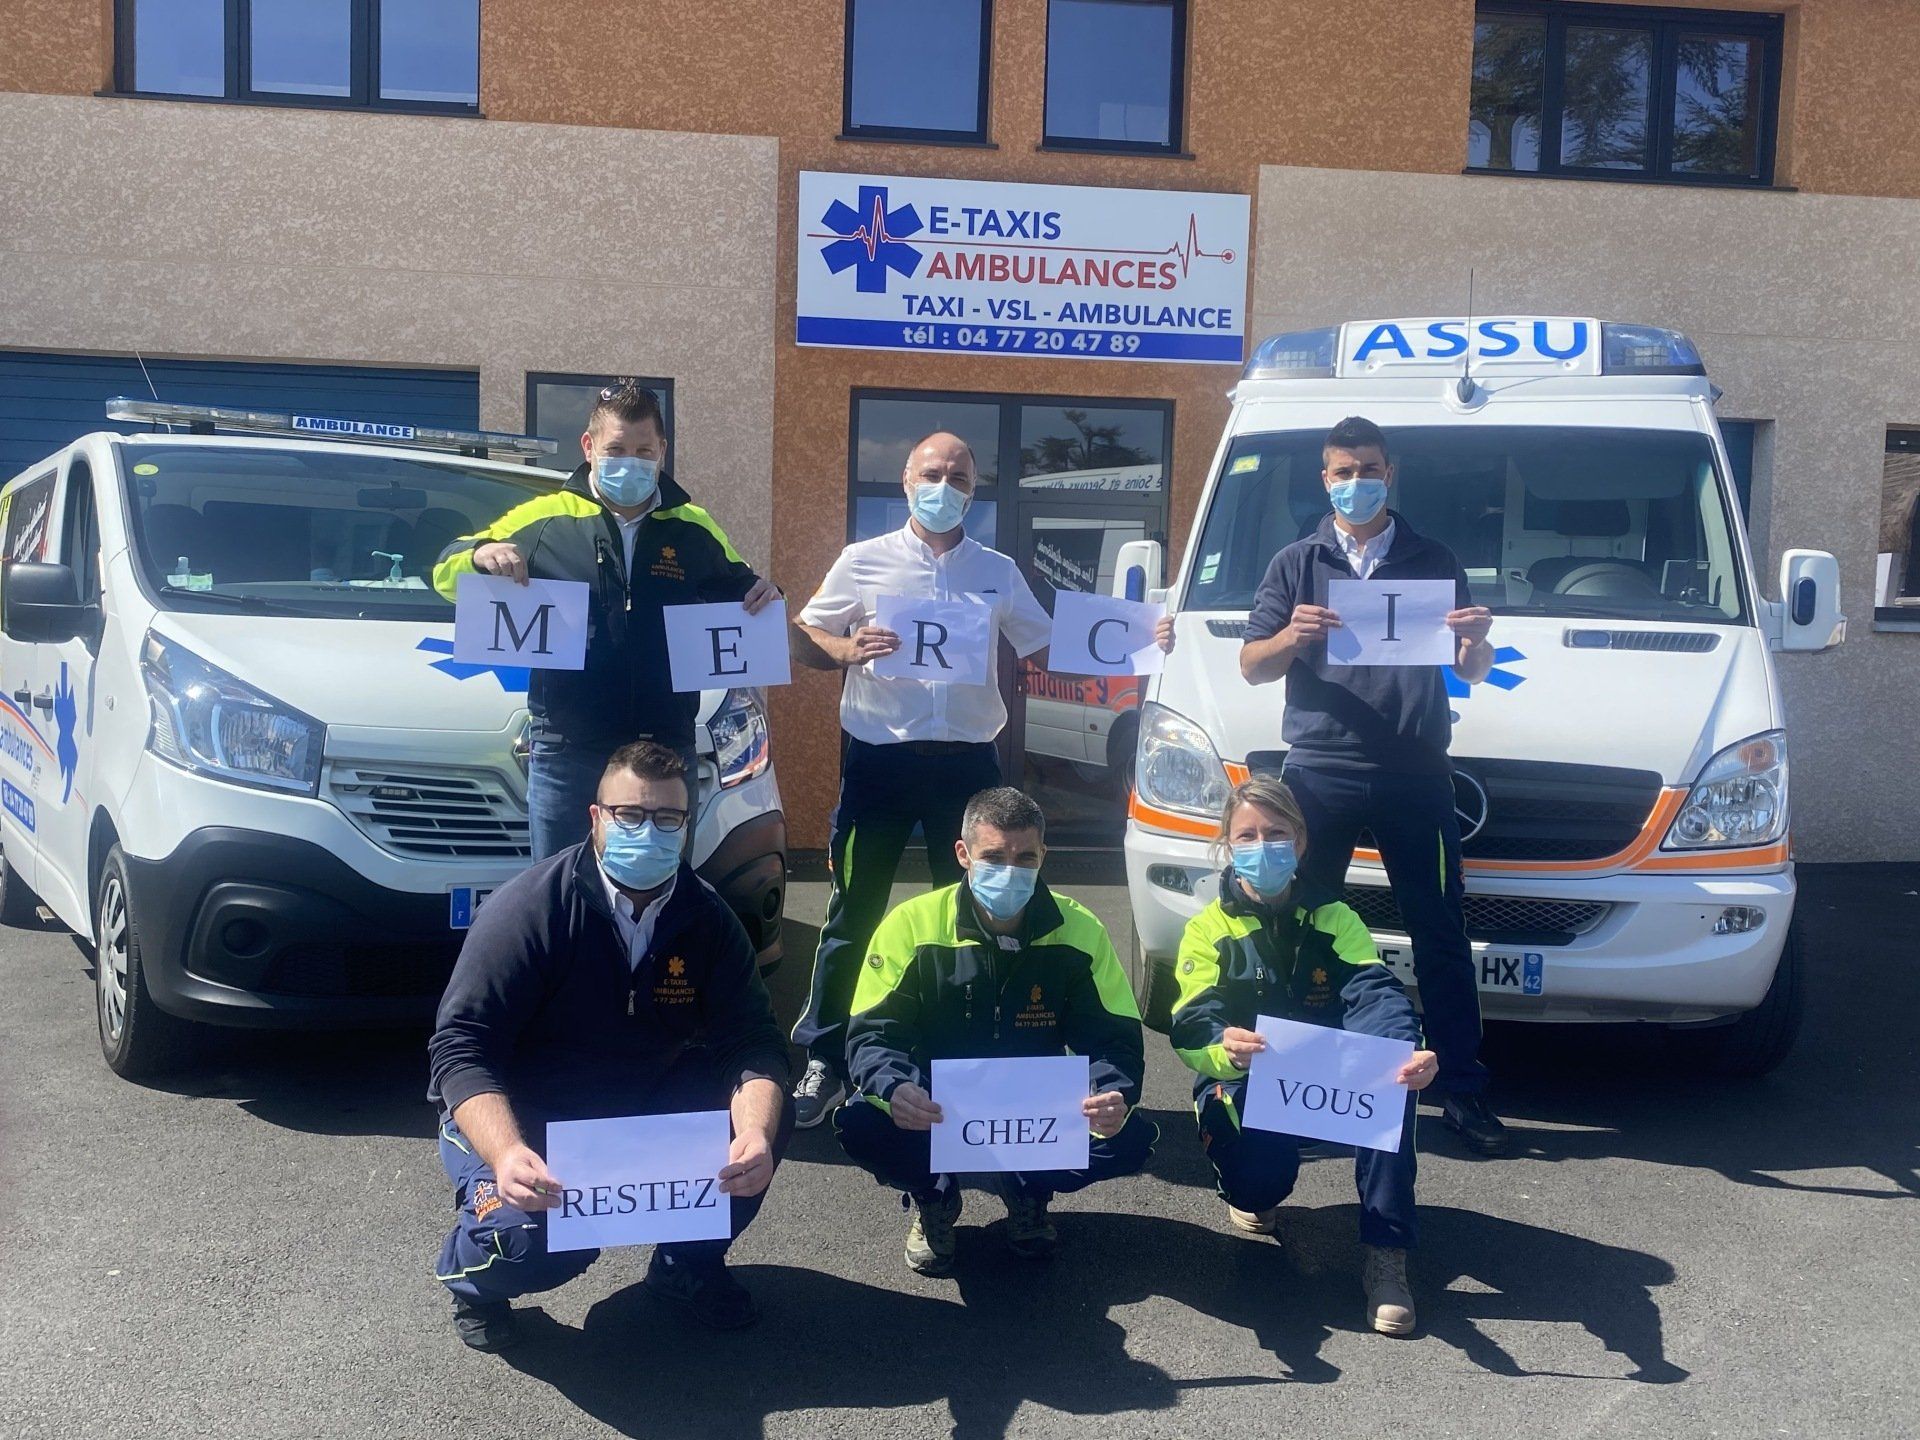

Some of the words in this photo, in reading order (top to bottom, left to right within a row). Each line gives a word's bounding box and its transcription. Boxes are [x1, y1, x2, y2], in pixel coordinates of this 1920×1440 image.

[928, 206, 1062, 240] E-TAXIS
[926, 251, 1178, 291] AMBULANCES
[902, 294, 964, 318] TAXI
[987, 298, 1036, 321] VSL
[1057, 302, 1232, 329] AMBULANCE
[902, 325, 935, 345] tél
[957, 327, 988, 346] 04
[996, 329, 1026, 348] 77
[1034, 331, 1065, 350] 20
[1071, 333, 1102, 352] 47
[1109, 335, 1142, 353] 89
[1352, 321, 1587, 362] ASSU
[295, 417, 412, 438] AMBULANCE
[487, 600, 556, 654] M
[1380, 592, 1402, 642] I
[705, 626, 748, 676] E
[909, 620, 953, 669] R
[1087, 618, 1129, 665] C
[1481, 956, 1520, 986] HX
[1525, 975, 1541, 990] 42
[1277, 1078, 1376, 1120] VOUS
[962, 1116, 1058, 1146] CHEZ
[560, 1177, 717, 1219] RESTEZ
